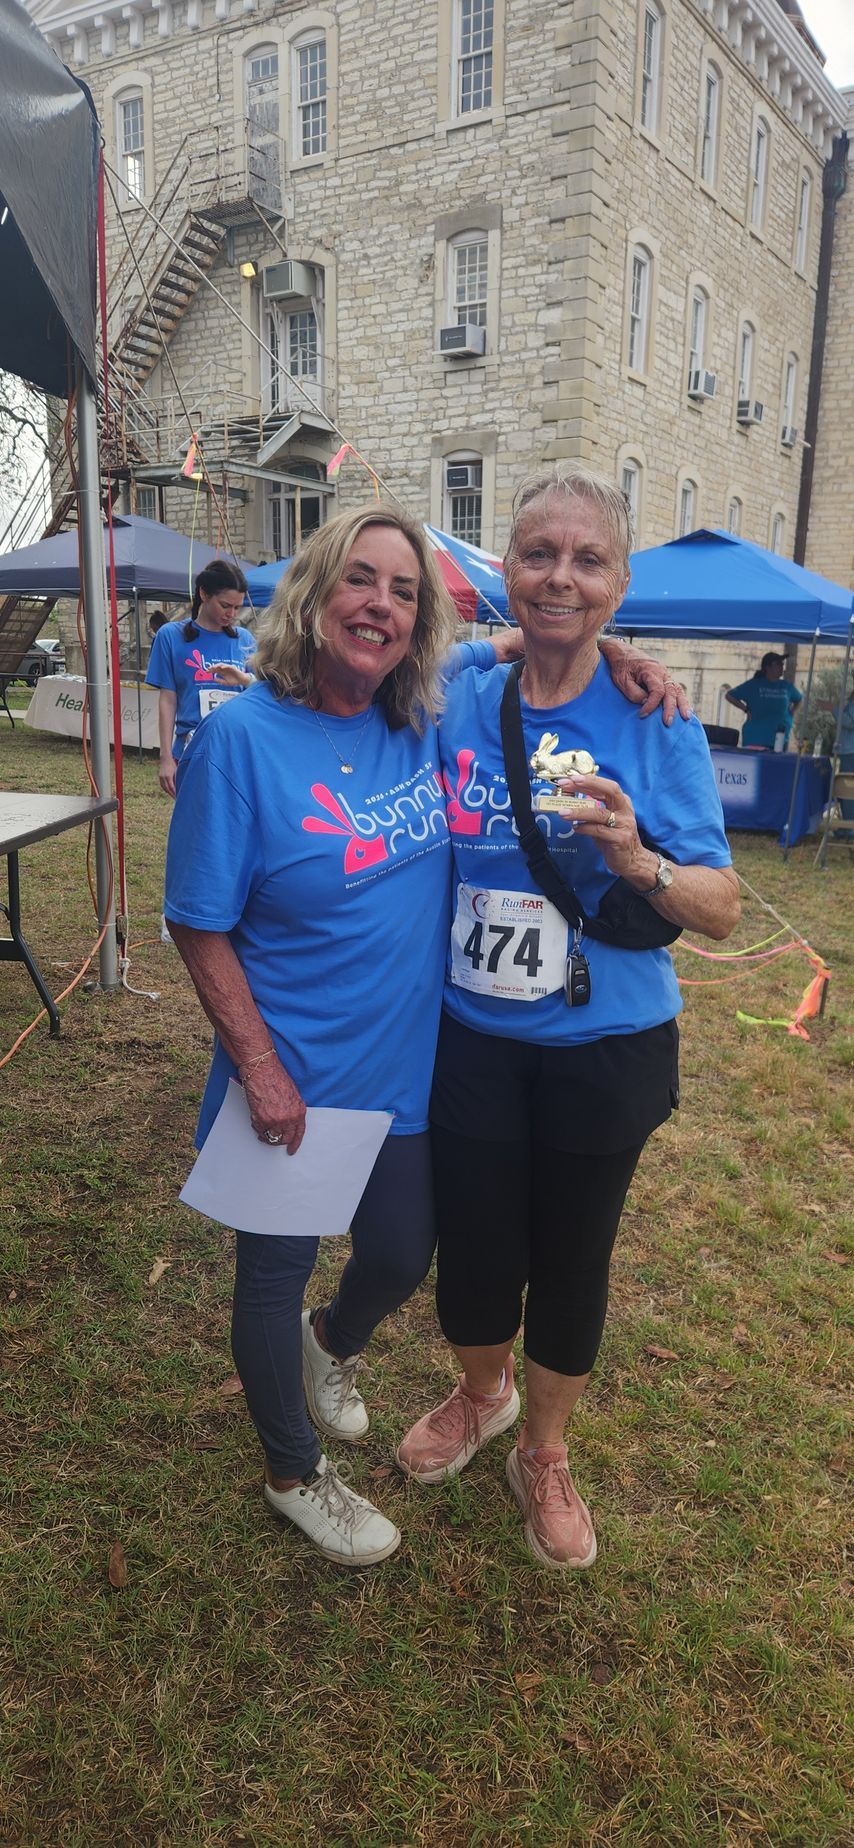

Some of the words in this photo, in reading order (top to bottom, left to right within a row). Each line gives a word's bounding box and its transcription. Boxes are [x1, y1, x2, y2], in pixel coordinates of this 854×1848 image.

[389, 783, 405, 796] ASH
[405, 768, 425, 786] DASH
[718, 768, 748, 785] Texas
[389, 809, 449, 855] run
[501, 897, 544, 910] RunFAR
[463, 920, 544, 978] 474
